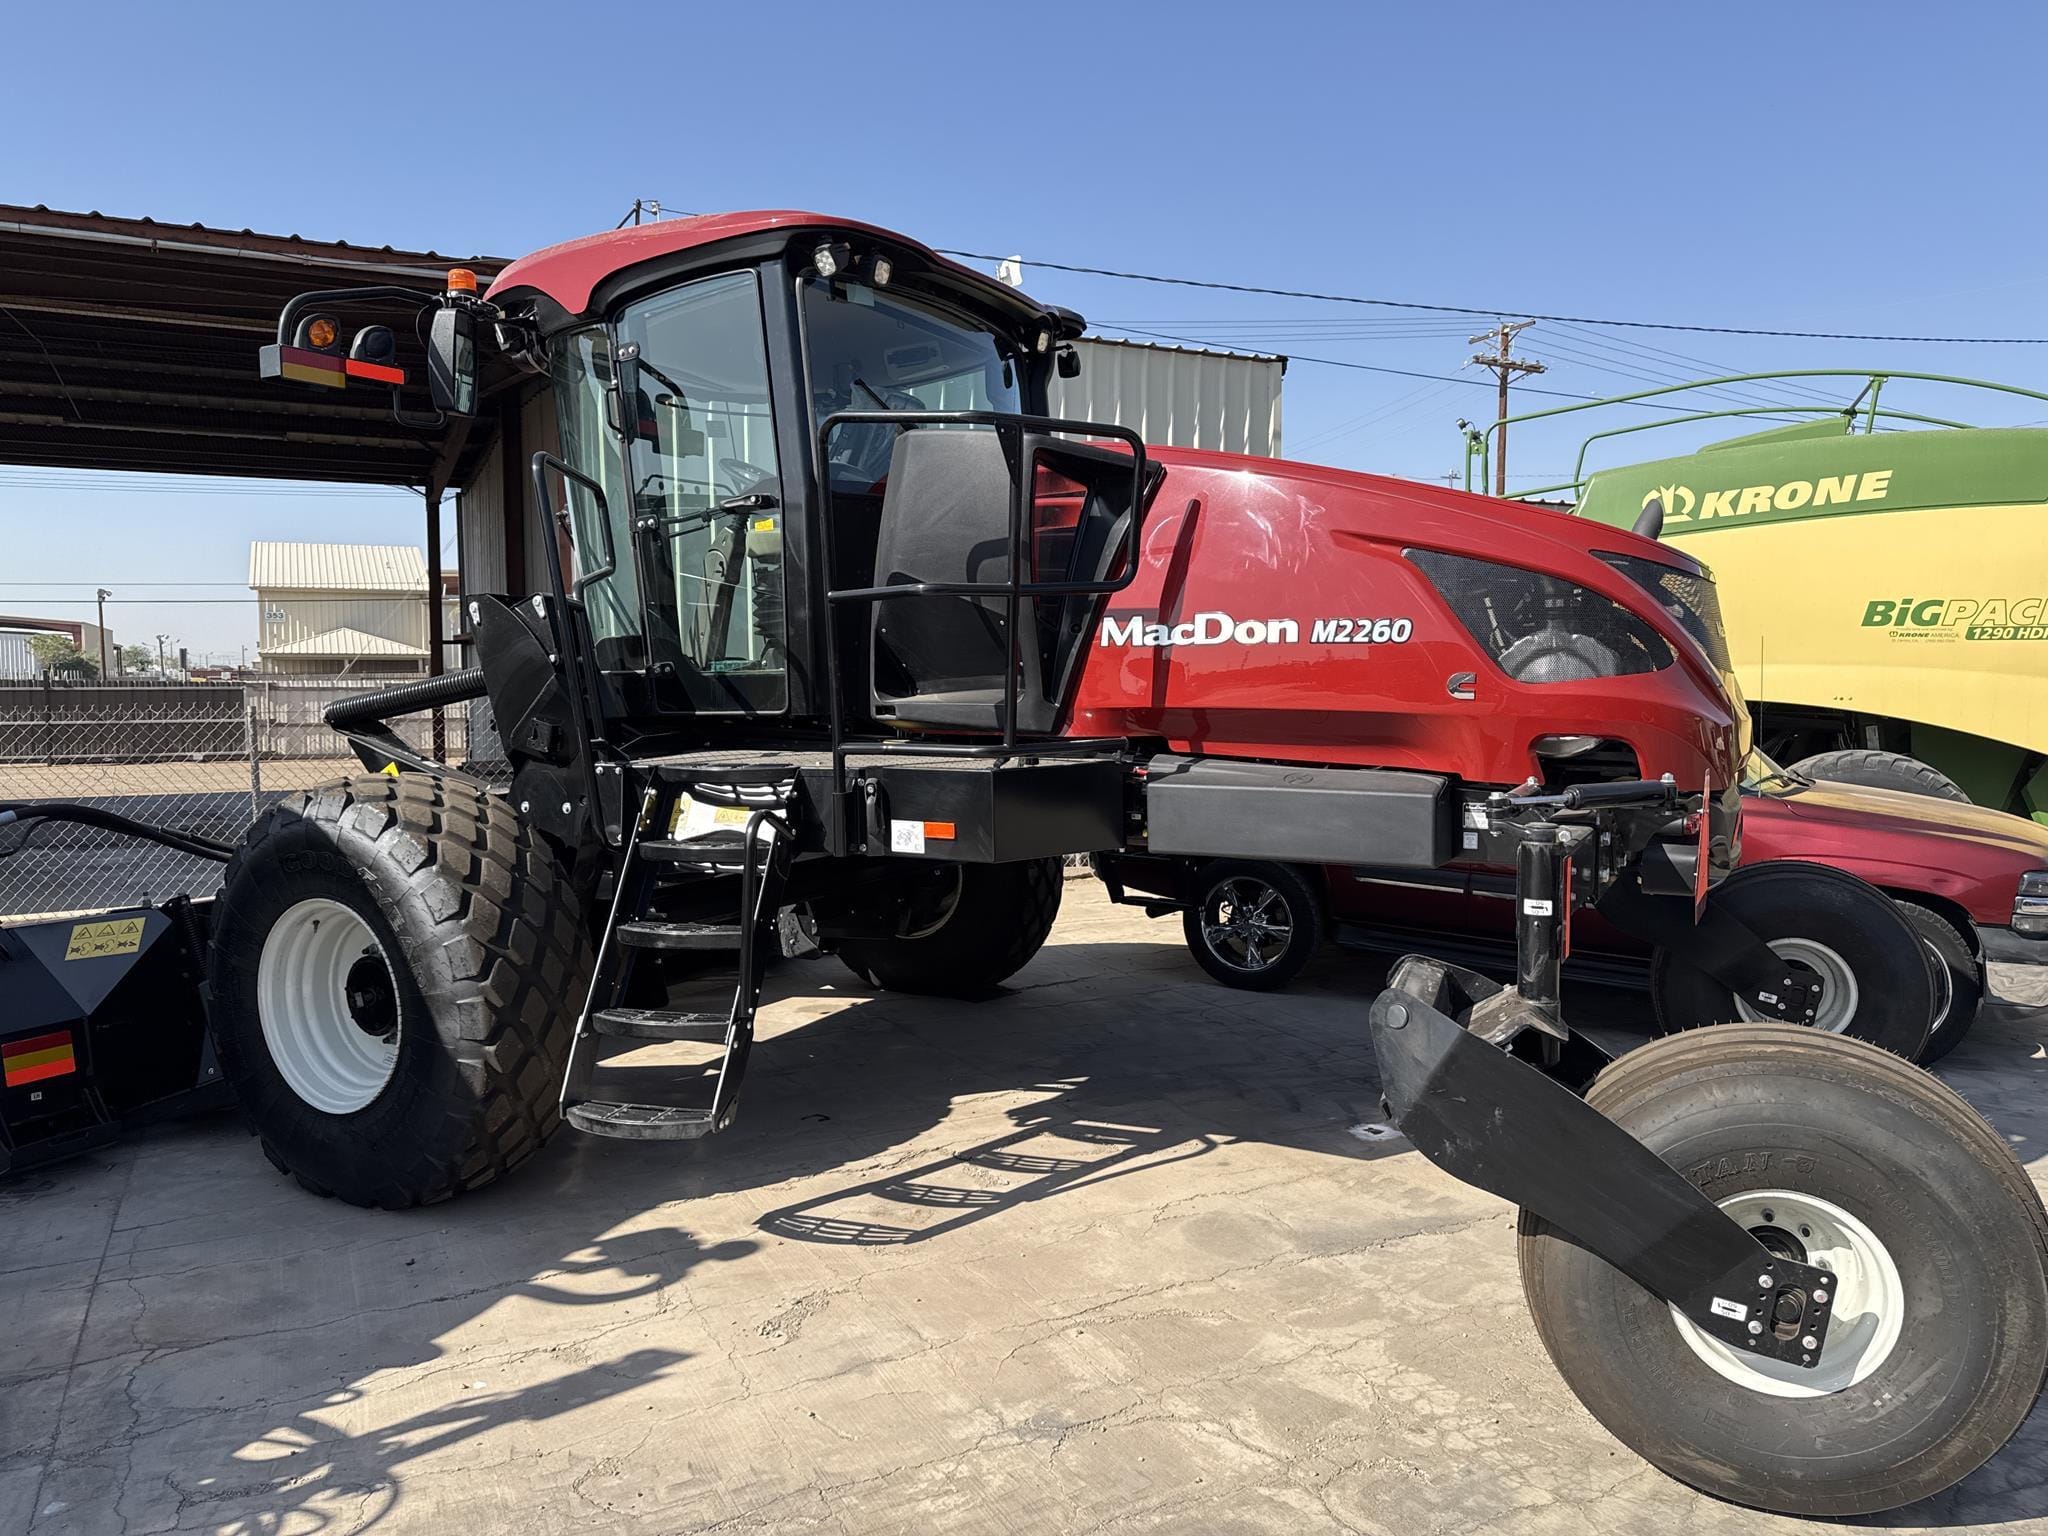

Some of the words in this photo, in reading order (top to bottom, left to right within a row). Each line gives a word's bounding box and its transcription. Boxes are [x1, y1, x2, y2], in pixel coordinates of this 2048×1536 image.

[1699, 470, 1893, 520] KRONE
[1100, 612, 1299, 647] MacDon
[1310, 618, 1412, 644] M2260
[1973, 627, 2014, 640] 1290
